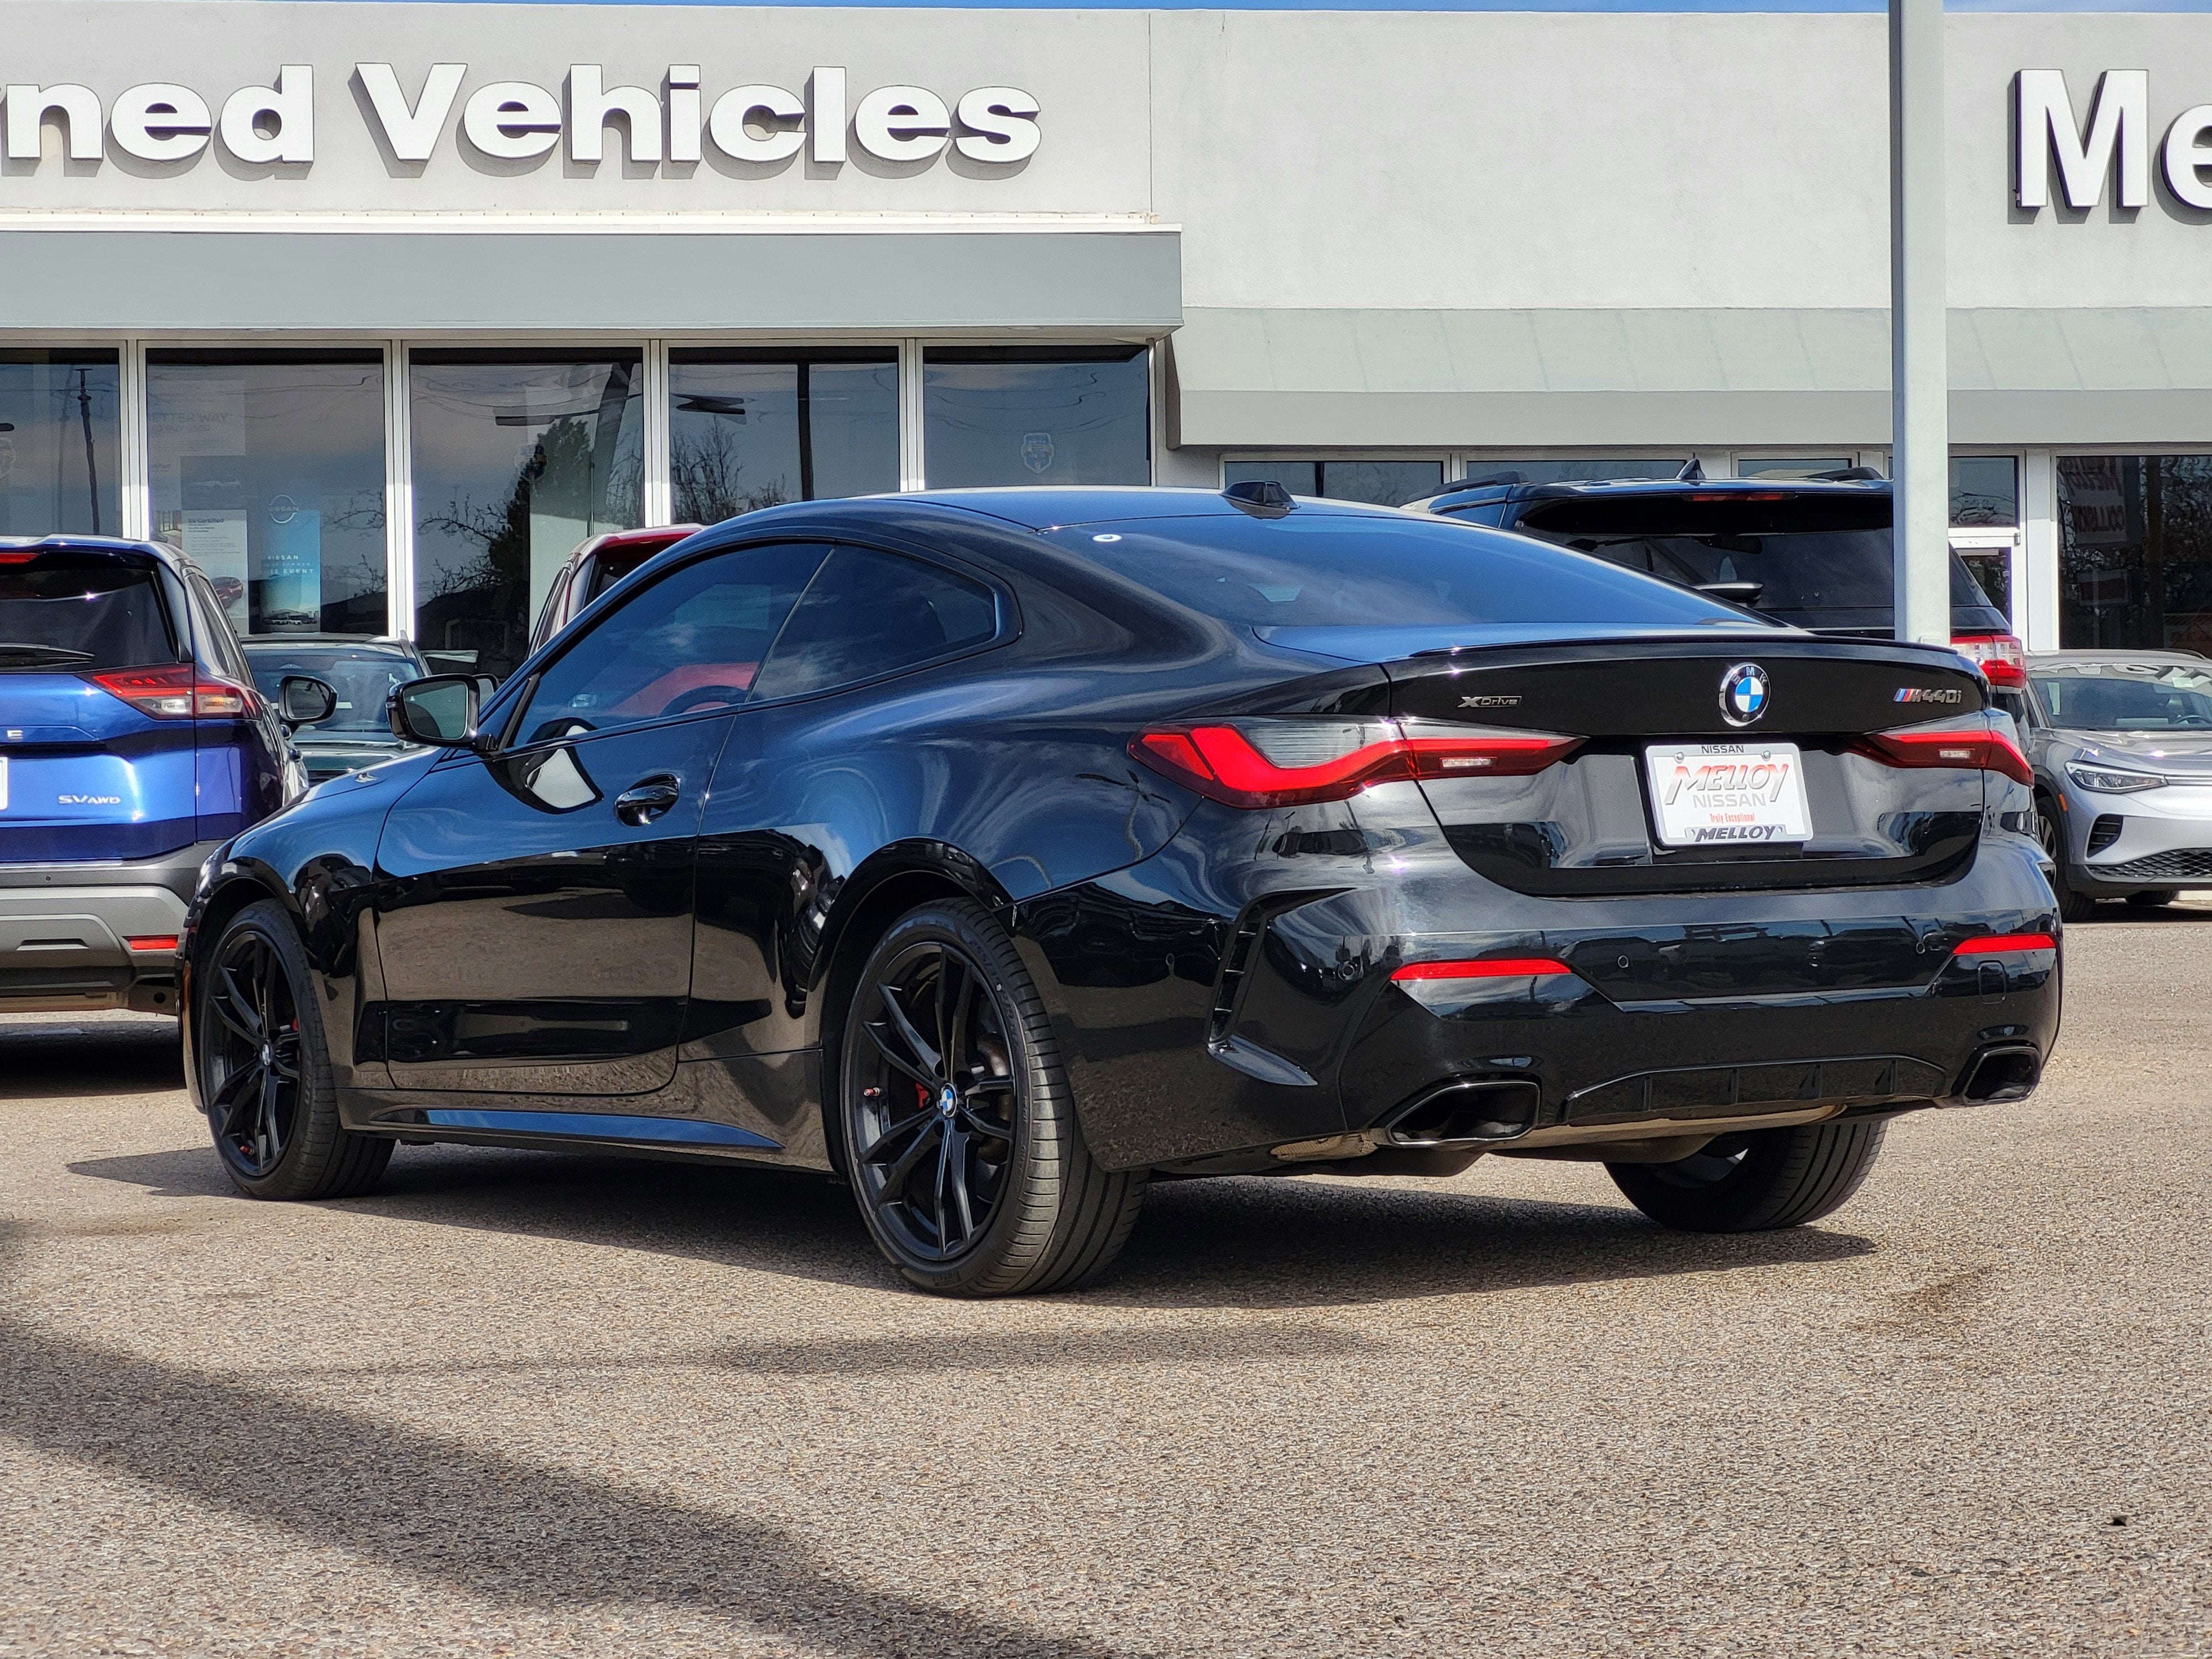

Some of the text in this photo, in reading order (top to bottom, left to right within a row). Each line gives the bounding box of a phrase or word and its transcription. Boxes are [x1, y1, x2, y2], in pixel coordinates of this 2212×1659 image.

[354, 63, 1042, 164] Vehicles
[1730, 666, 1768, 686] BMW
[1701, 745, 1744, 754] NISSAN
[1664, 764, 1789, 805] MELLOY
[1692, 793, 1766, 808] NISSAN
[1710, 812, 1756, 824] Truly Exceptional
[1694, 826, 1776, 842] MELLOY
